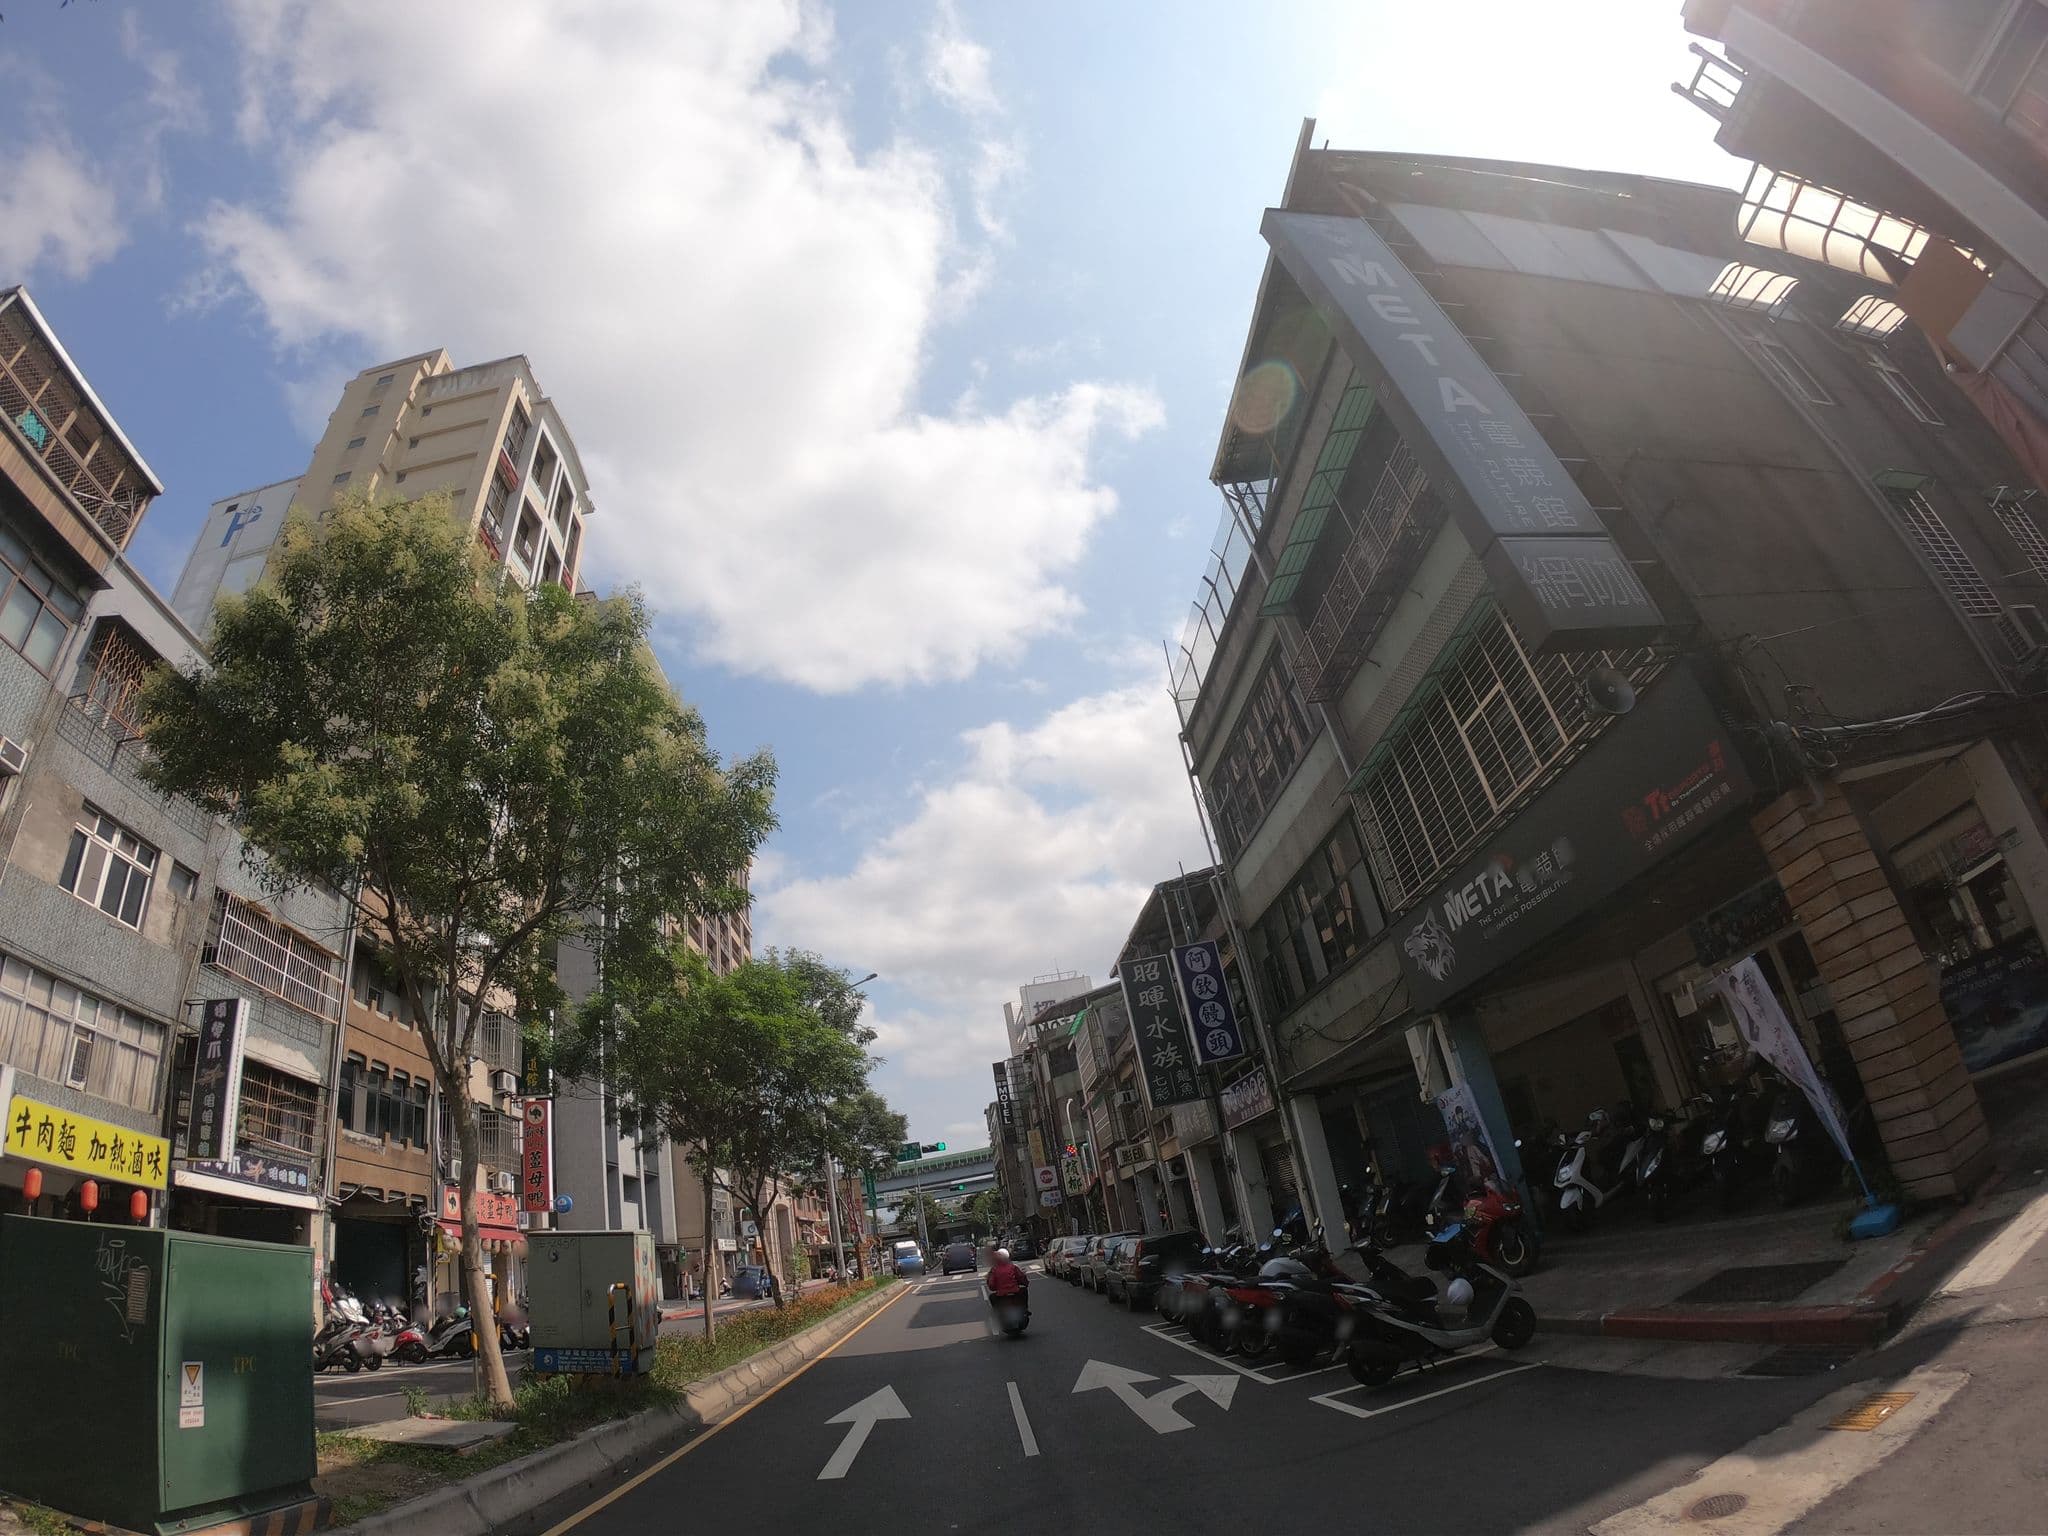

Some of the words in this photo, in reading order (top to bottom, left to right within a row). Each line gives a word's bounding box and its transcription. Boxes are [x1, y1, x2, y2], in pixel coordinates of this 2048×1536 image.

[1328, 255, 1492, 414] META
[1521, 552, 1650, 609] 網咖
[1442, 869, 1514, 932] META
[1133, 961, 1184, 1068] 昭暉水族
[1187, 948, 1231, 1053] 阿欽饅頭
[998, 1086, 1012, 1124] MOTEL
[1152, 1074, 1169, 1101] 七彩
[6, 1105, 76, 1161] 牛肉麵
[88, 1131, 163, 1181] 加熱滷味
[527, 1151, 546, 1208] 薑母鴨
